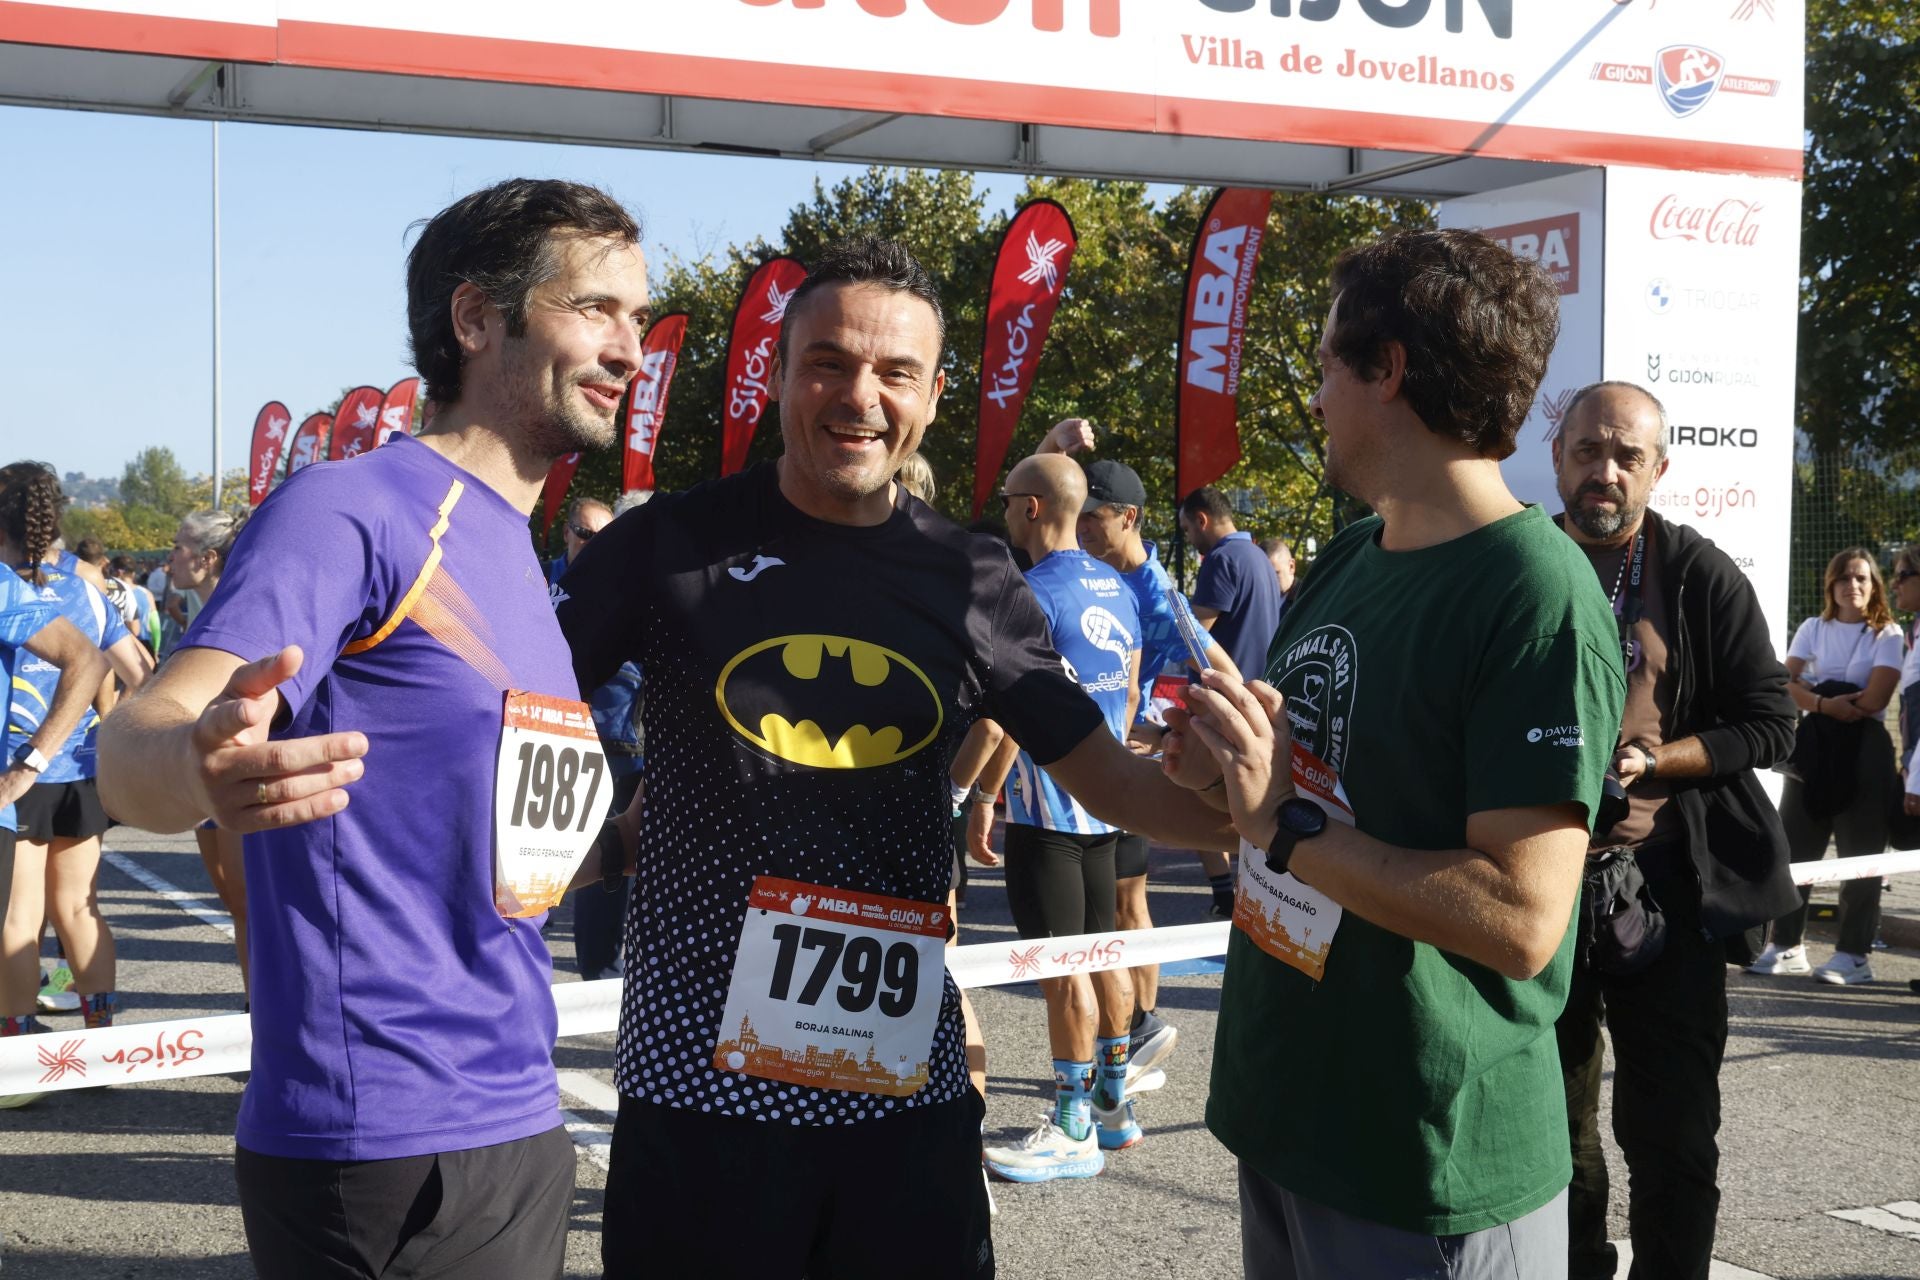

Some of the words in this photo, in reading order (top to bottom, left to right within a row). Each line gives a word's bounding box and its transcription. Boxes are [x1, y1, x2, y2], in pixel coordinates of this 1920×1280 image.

[1181, 34, 1264, 70] Villa
[1280, 44, 1323, 74] de
[1337, 48, 1515, 92] Jovellanos
[1605, 64, 1649, 82] GIJÓN
[1722, 77, 1771, 94] ATLETISMO
[1494, 228, 1570, 270] BA
[1232, 227, 1262, 329] EMPOWERMENT
[730, 337, 772, 424] gijón
[1227, 332, 1241, 396] SURGICAL
[1669, 426, 1757, 447] IROKO
[1695, 481, 1755, 517] gijón
[1630, 564, 1641, 586] EOS
[1286, 634, 1341, 668] FINALS
[1098, 671, 1125, 682] CLUB
[510, 741, 604, 833] 1987
[817, 897, 859, 915] MBA
[861, 910, 889, 921] maratón
[862, 904, 884, 913] media
[889, 908, 925, 926] GIJÓN
[769, 923, 919, 1018] 1799
[1052, 939, 1126, 972] gijón
[795, 1021, 830, 1034] BORJA
[832, 1026, 874, 1040] SALINAS
[102, 1029, 205, 1074] gijón
